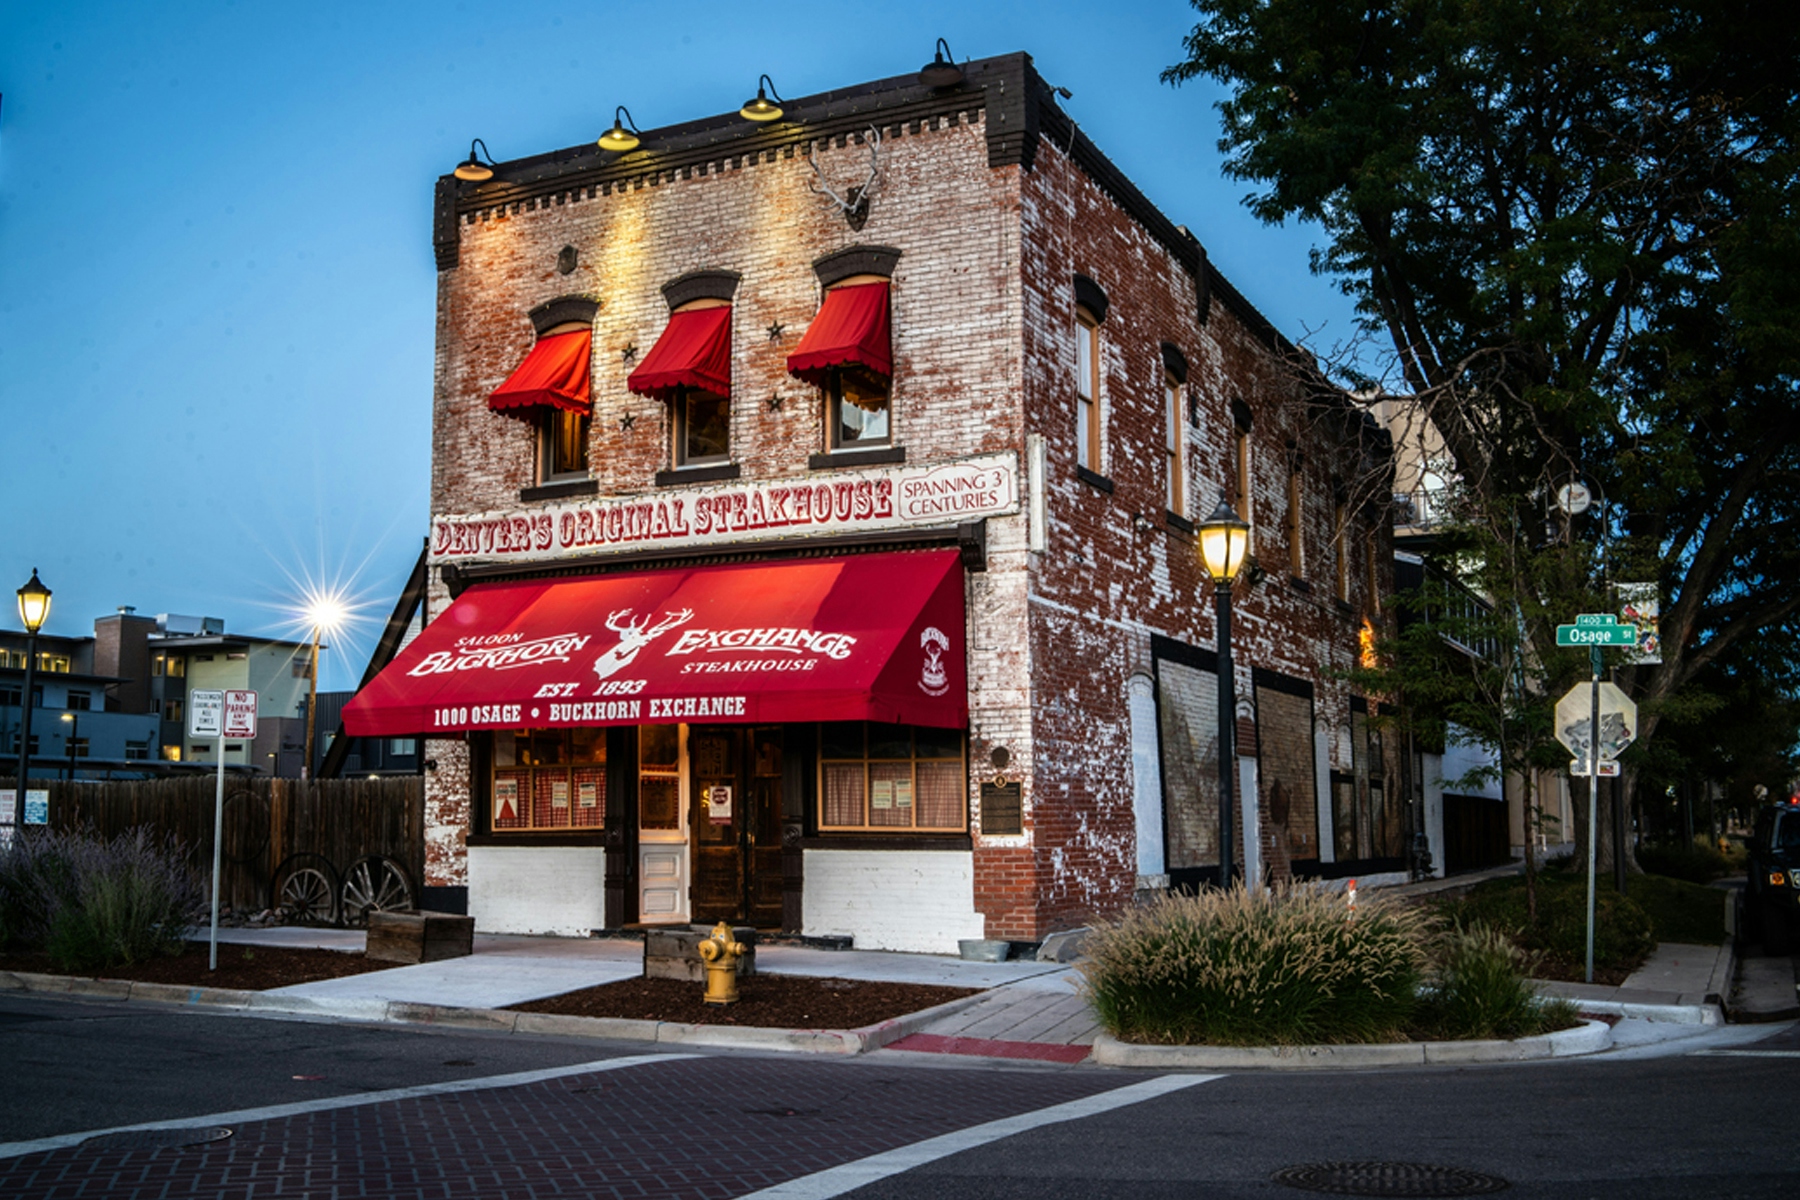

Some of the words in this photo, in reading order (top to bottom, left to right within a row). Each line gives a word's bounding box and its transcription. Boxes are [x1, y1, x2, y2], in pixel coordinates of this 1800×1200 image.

[904, 475, 986, 499] SPANNING
[993, 471, 1003, 488] 3
[908, 489, 999, 516] CENTURIES
[434, 514, 553, 555] DENVER'S
[559, 500, 690, 548] ORIGINAL
[694, 478, 894, 535] STEAKHOUSE
[1580, 616, 1602, 625] 1400
[454, 632, 524, 648] SALOON
[665, 627, 858, 660] EXCHANGE
[1569, 628, 1612, 645] Osage
[406, 634, 592, 677] BUCKHORN
[680, 658, 818, 675] STEAKHOUSE
[234, 693, 247, 703] NO
[533, 682, 580, 698] EST.
[593, 680, 648, 696] 1893
[227, 704, 255, 714] PARKING
[434, 707, 468, 726] 1000
[471, 704, 522, 724] OSAGE
[549, 700, 642, 722] BUCKHORN
[649, 696, 747, 718] EXCHANGE
